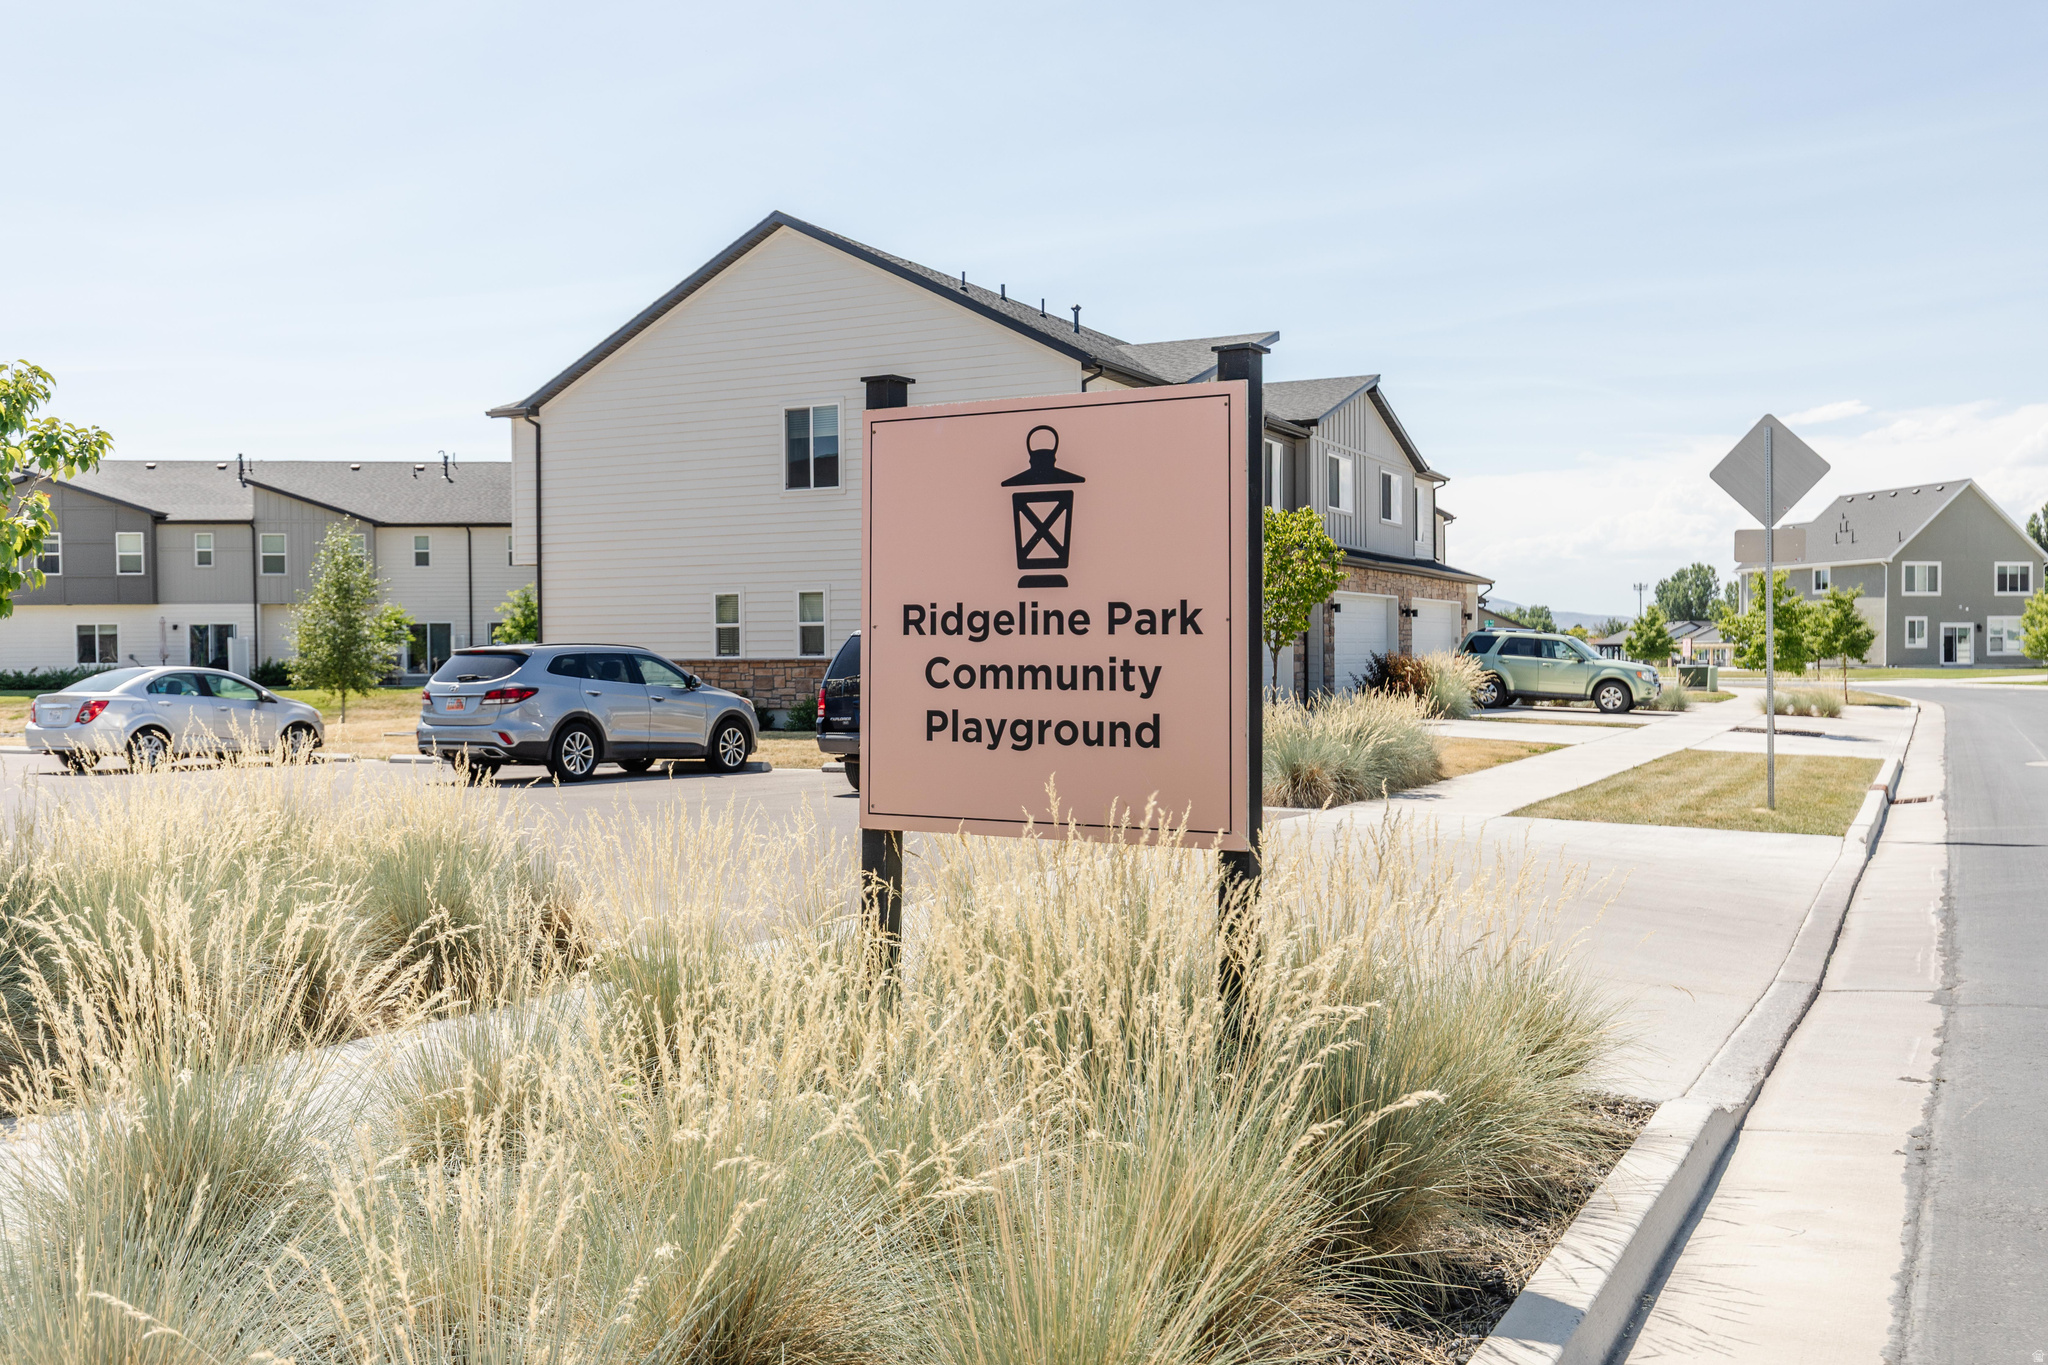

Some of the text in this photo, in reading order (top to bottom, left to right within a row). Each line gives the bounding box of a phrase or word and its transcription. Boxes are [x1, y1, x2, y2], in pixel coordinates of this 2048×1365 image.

[903, 599, 1203, 642] Ridgeline Park
[925, 656, 1162, 699] Community
[926, 709, 1160, 751] Playground
